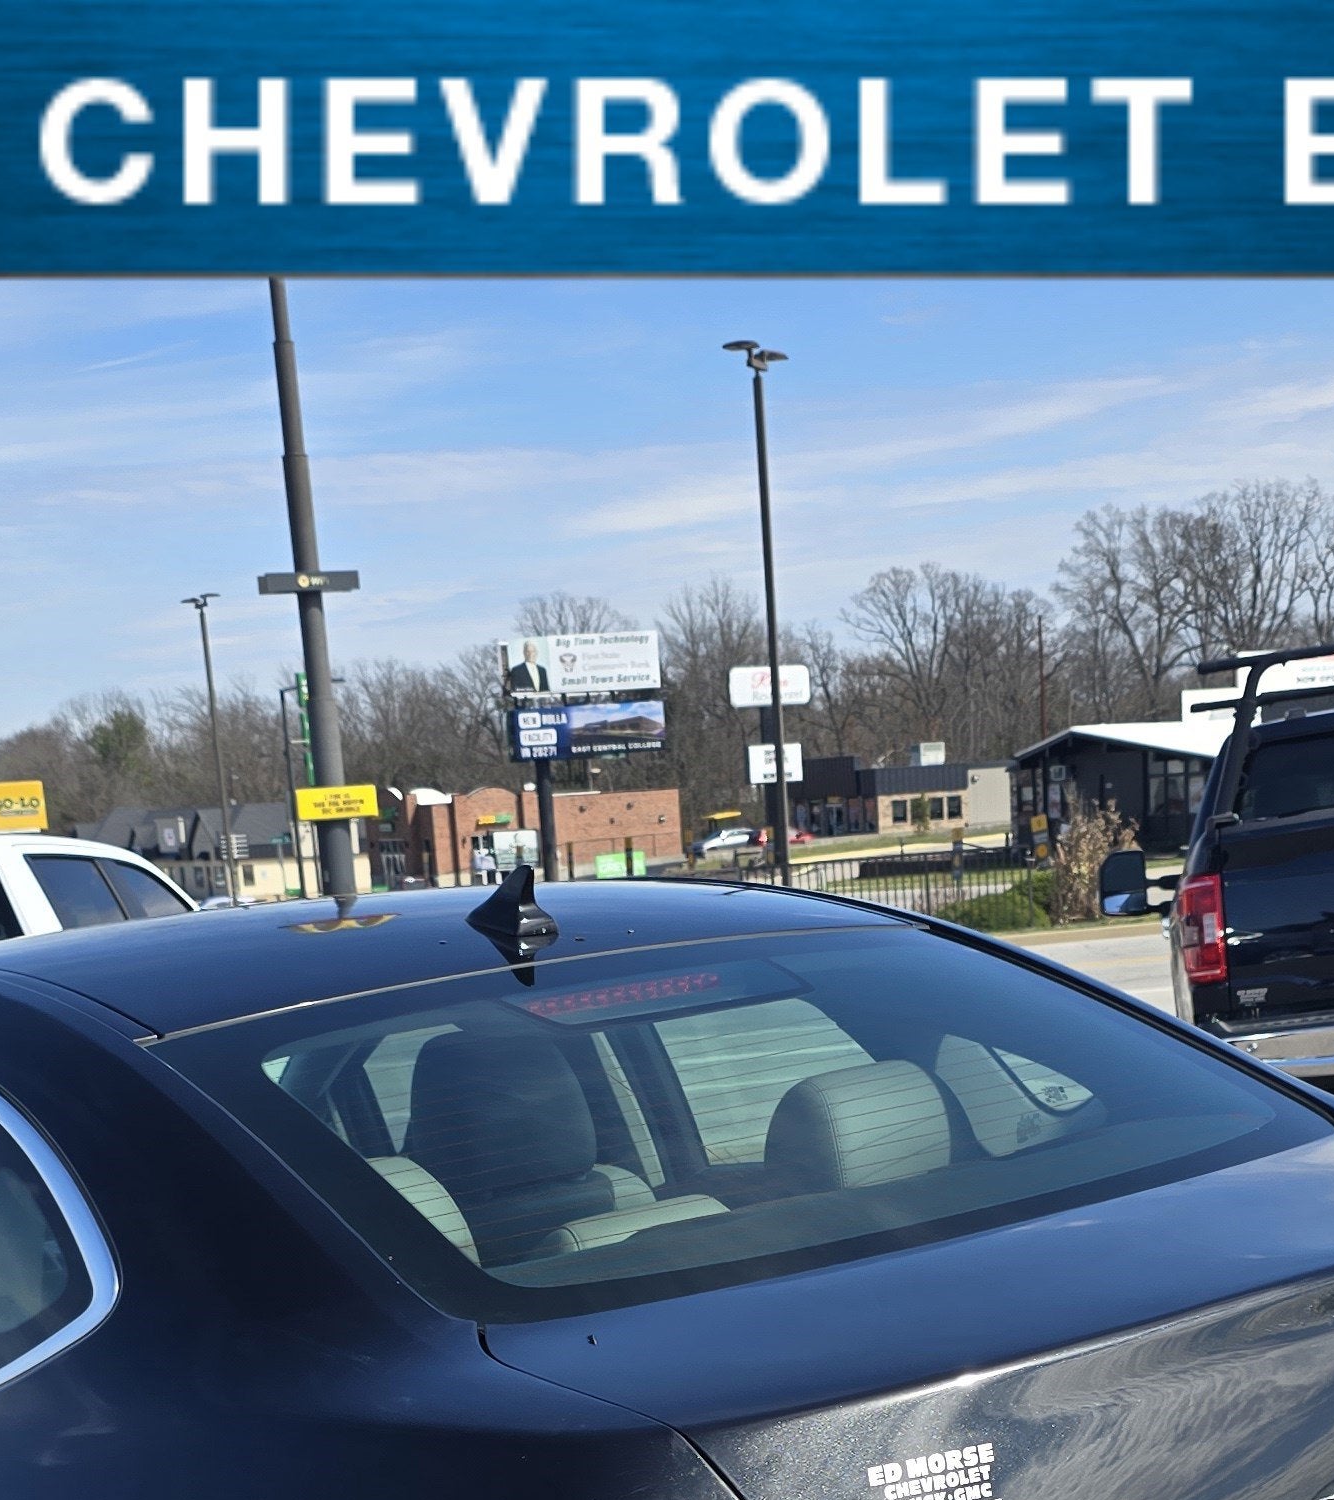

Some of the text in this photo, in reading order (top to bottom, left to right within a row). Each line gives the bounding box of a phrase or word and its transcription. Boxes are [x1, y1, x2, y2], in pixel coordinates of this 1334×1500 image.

[867, 1442, 995, 1487] ED MORSE
[884, 1465, 991, 1500] CHEVROLET
